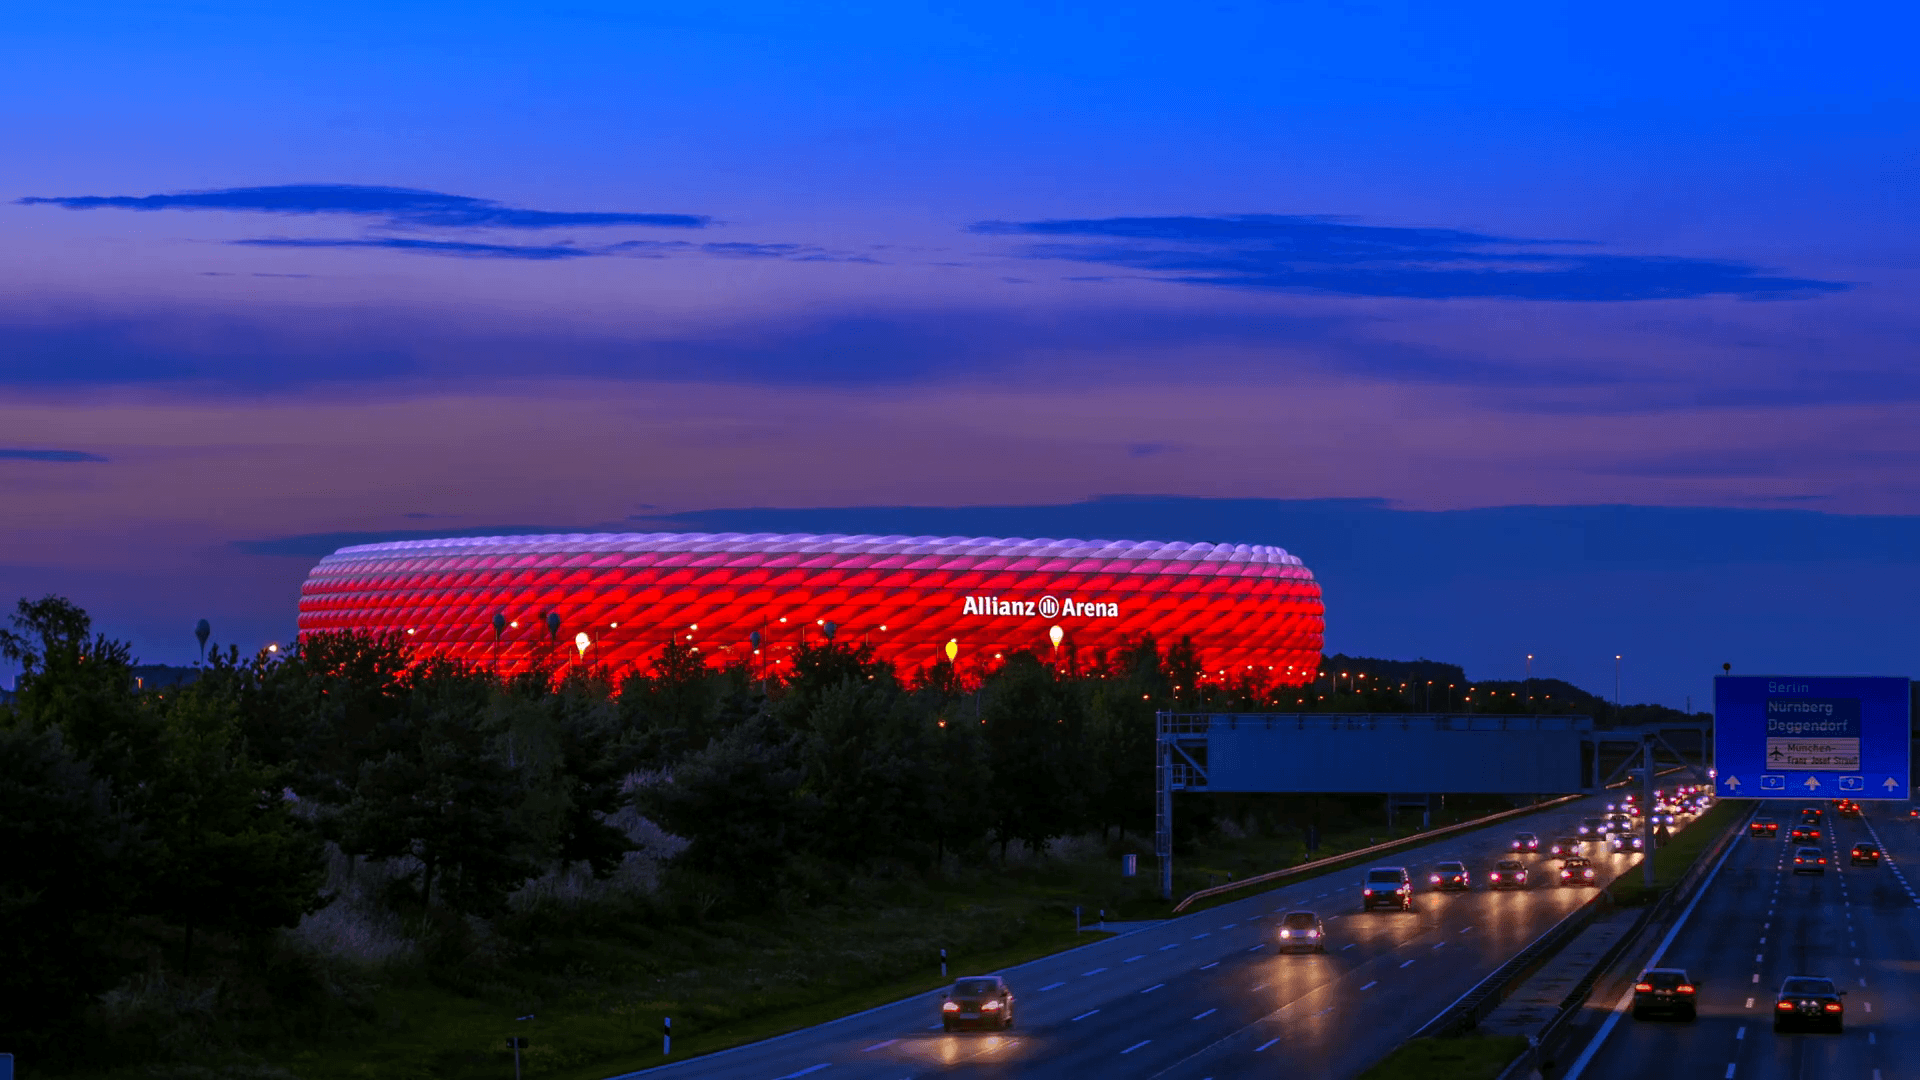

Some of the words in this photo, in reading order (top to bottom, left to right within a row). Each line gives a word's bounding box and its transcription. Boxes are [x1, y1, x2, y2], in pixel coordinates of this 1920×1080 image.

[963, 596, 1036, 615] Allianz
[1062, 597, 1118, 617] Arena
[1768, 680, 1809, 693] Berlin
[1768, 700, 1833, 716] Nürnberg
[1768, 718, 1848, 734] Deggendorf
